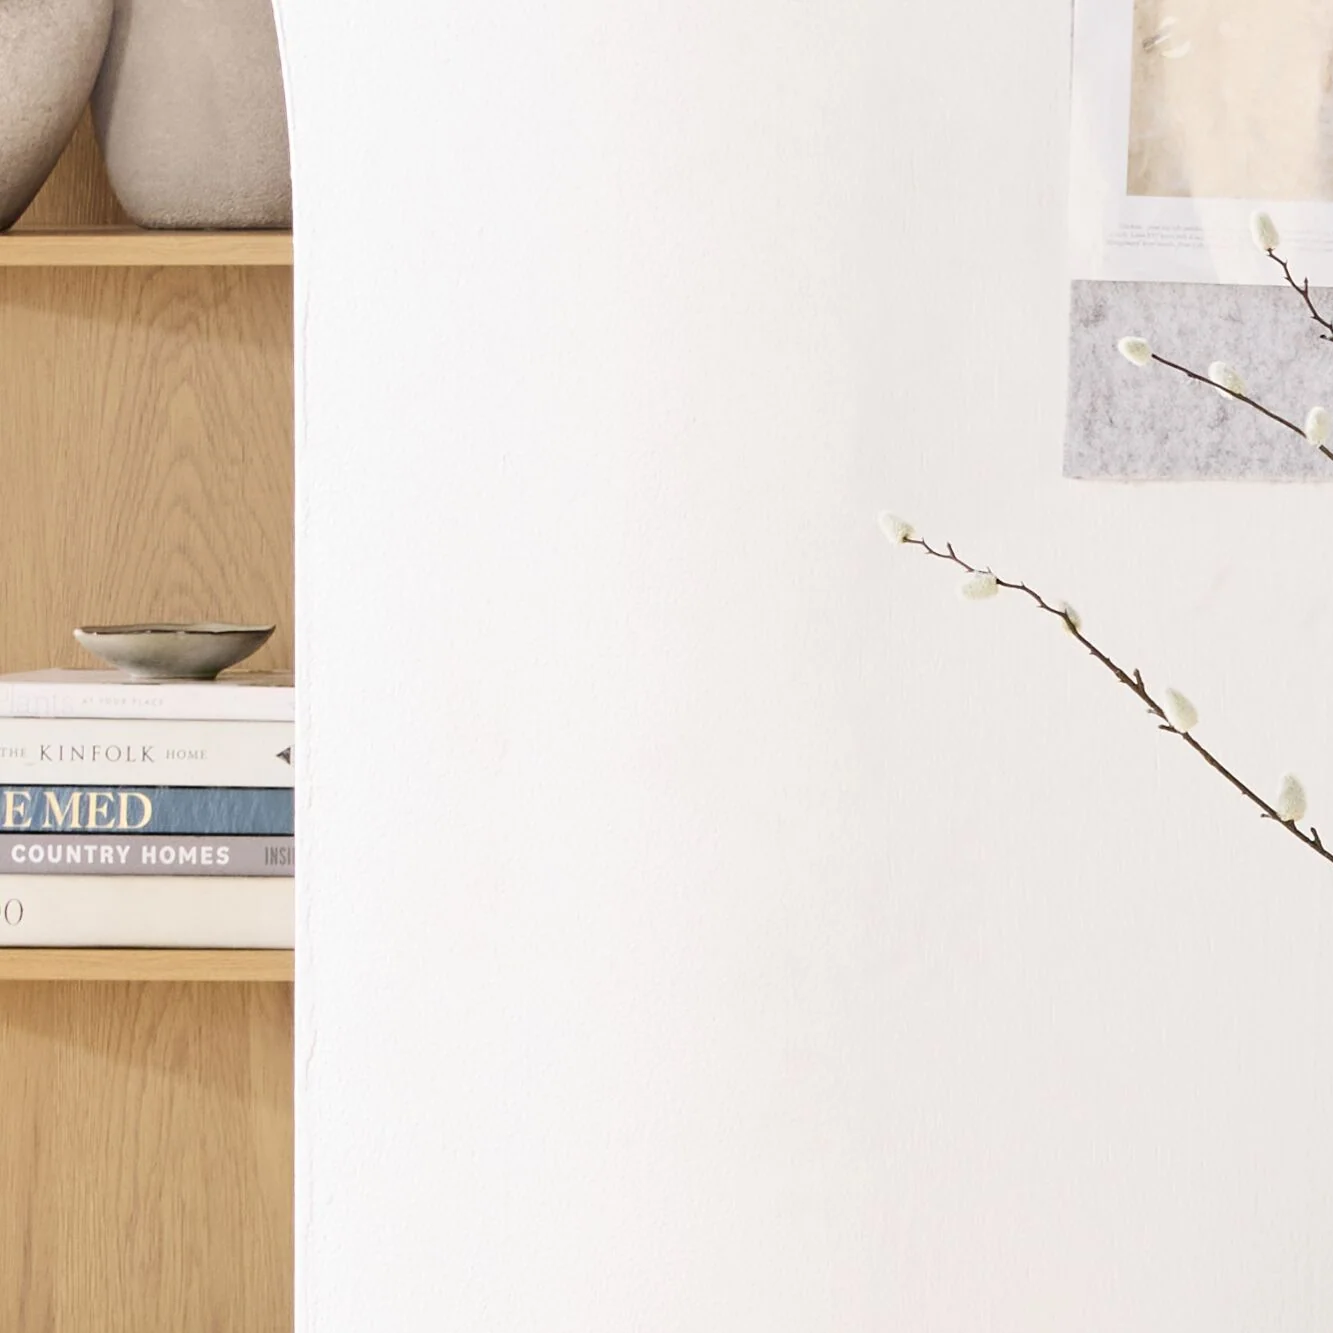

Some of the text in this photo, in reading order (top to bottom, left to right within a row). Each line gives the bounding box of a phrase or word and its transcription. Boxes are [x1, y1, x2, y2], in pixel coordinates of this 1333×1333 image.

[40, 744, 155, 762] KINFOLK
[166, 748, 207, 760] HOME
[43, 791, 152, 829] MED
[11, 843, 295, 866] COUNTRY HOMES INSI
